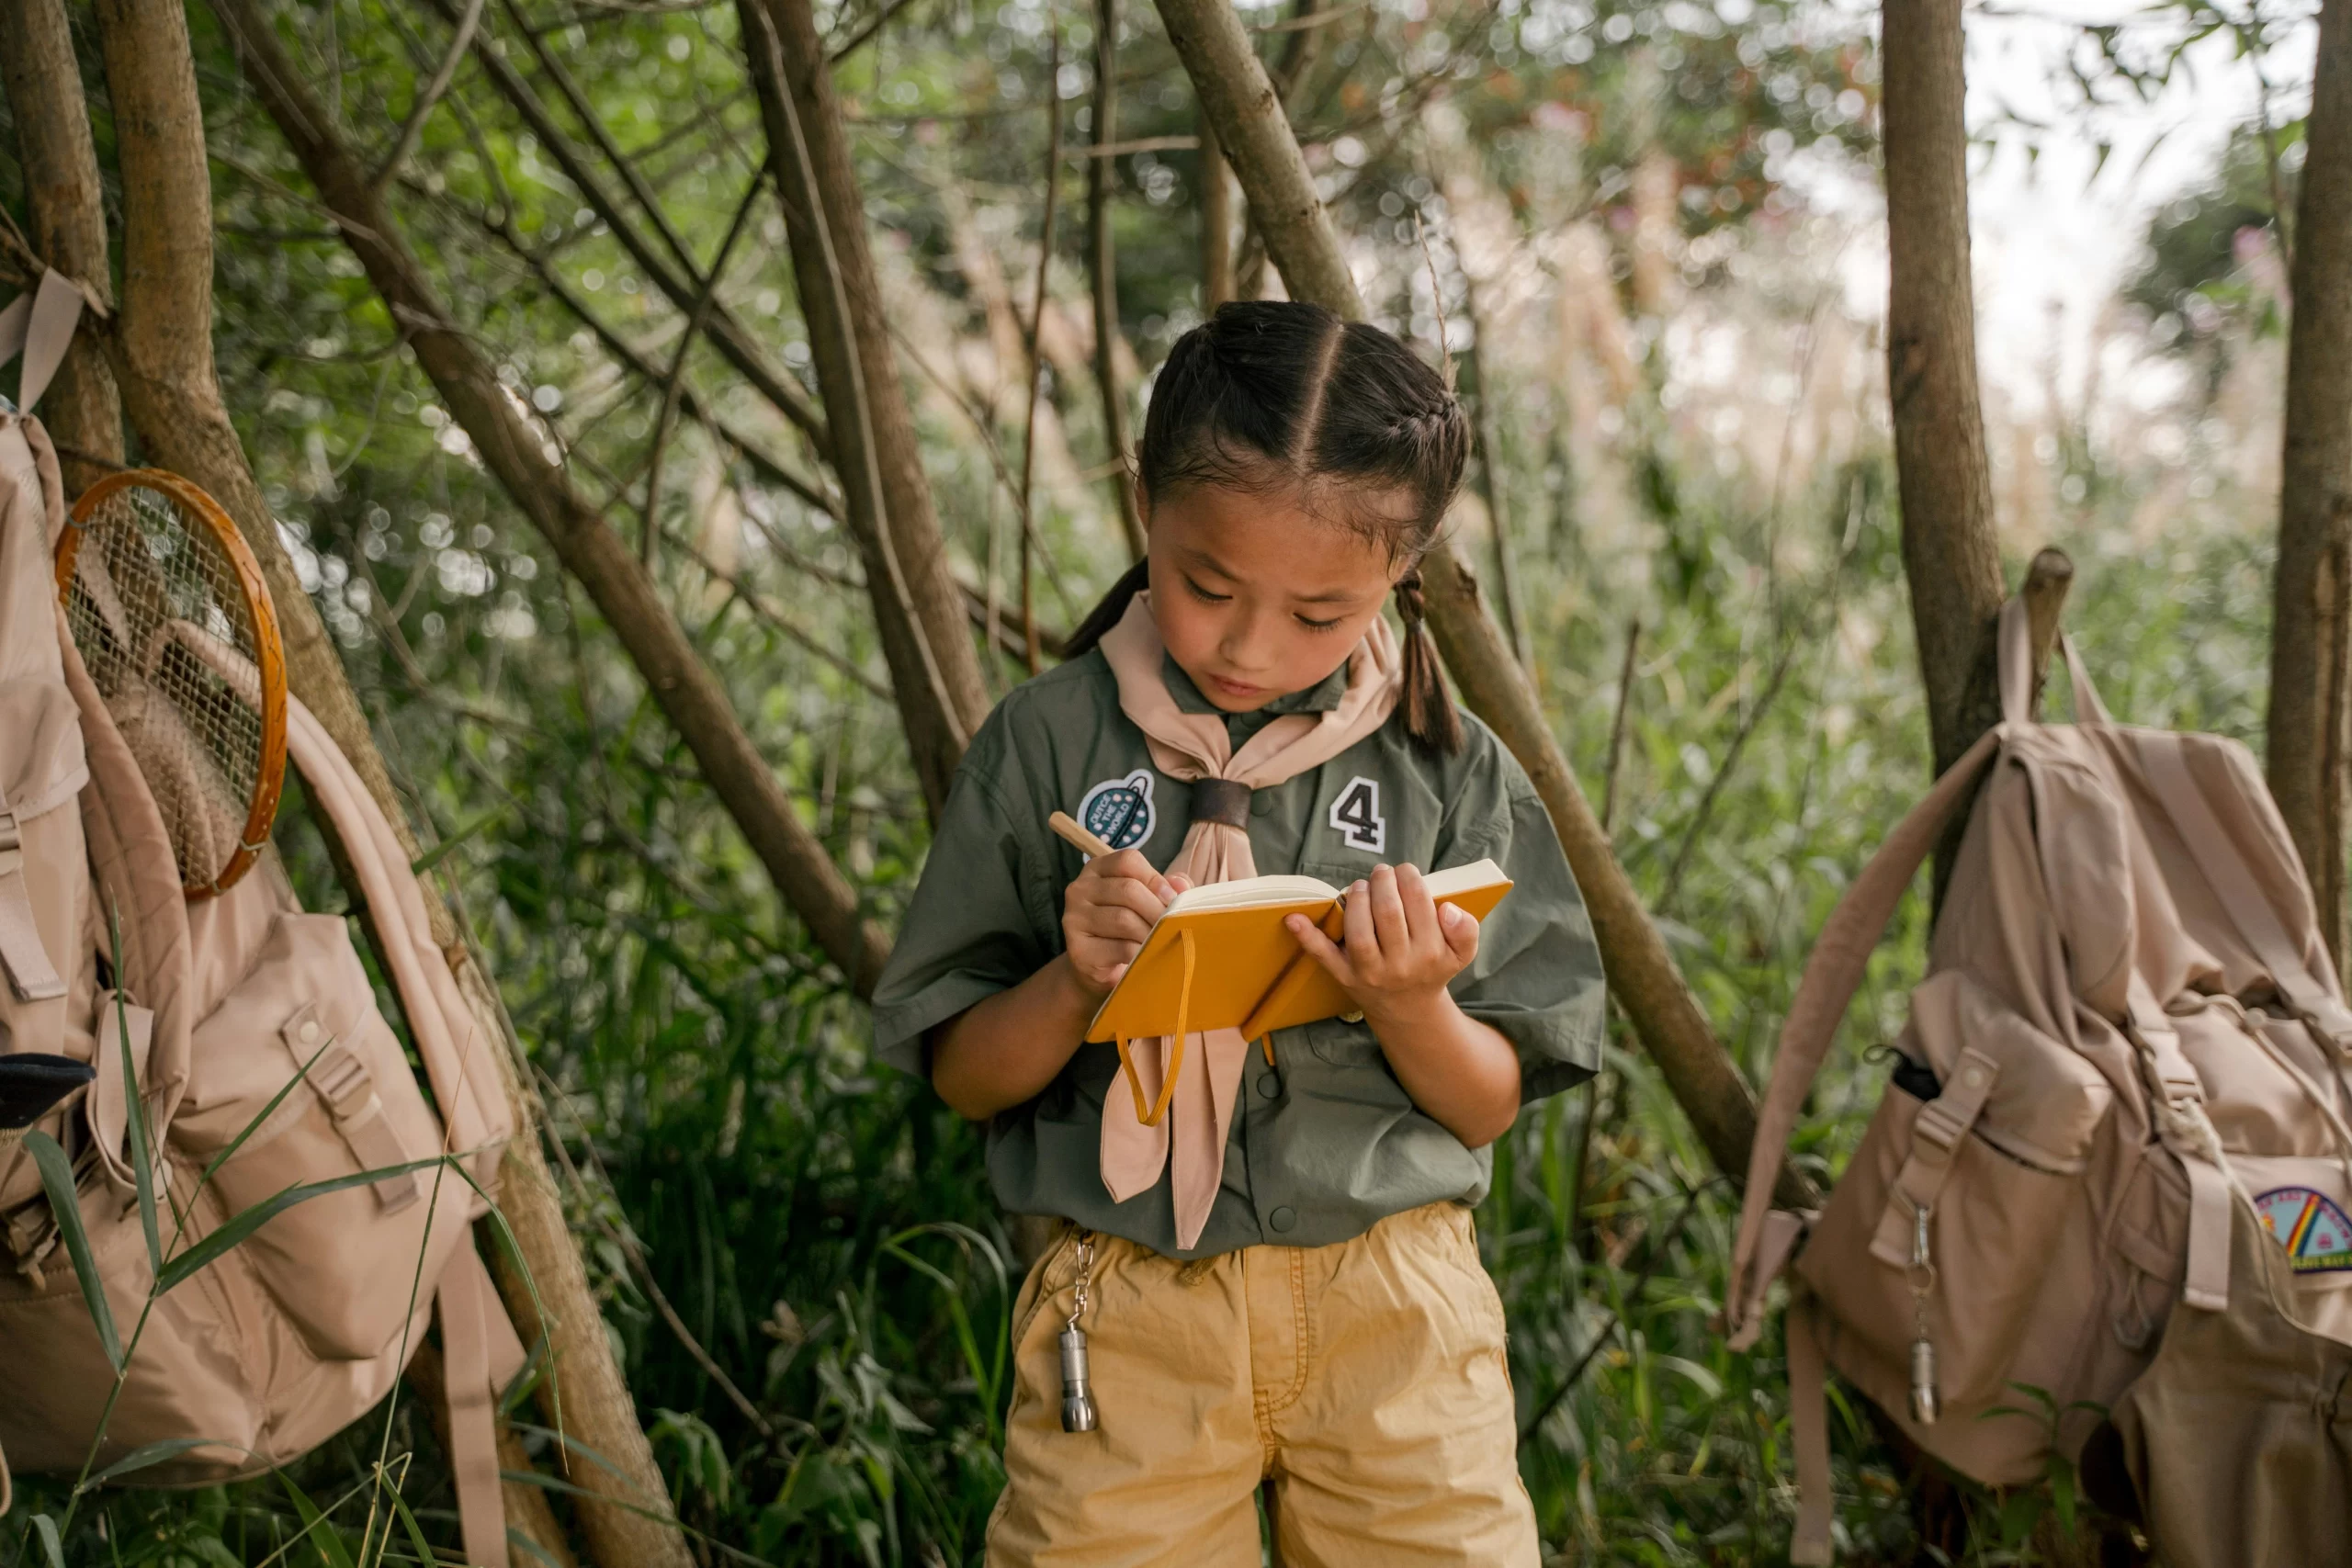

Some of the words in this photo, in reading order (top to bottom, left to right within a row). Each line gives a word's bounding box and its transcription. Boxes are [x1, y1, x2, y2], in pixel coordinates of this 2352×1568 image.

[1101, 804, 1116, 821] THE
[1105, 803, 1130, 835] WORLD
[1336, 782, 1380, 847] 4
